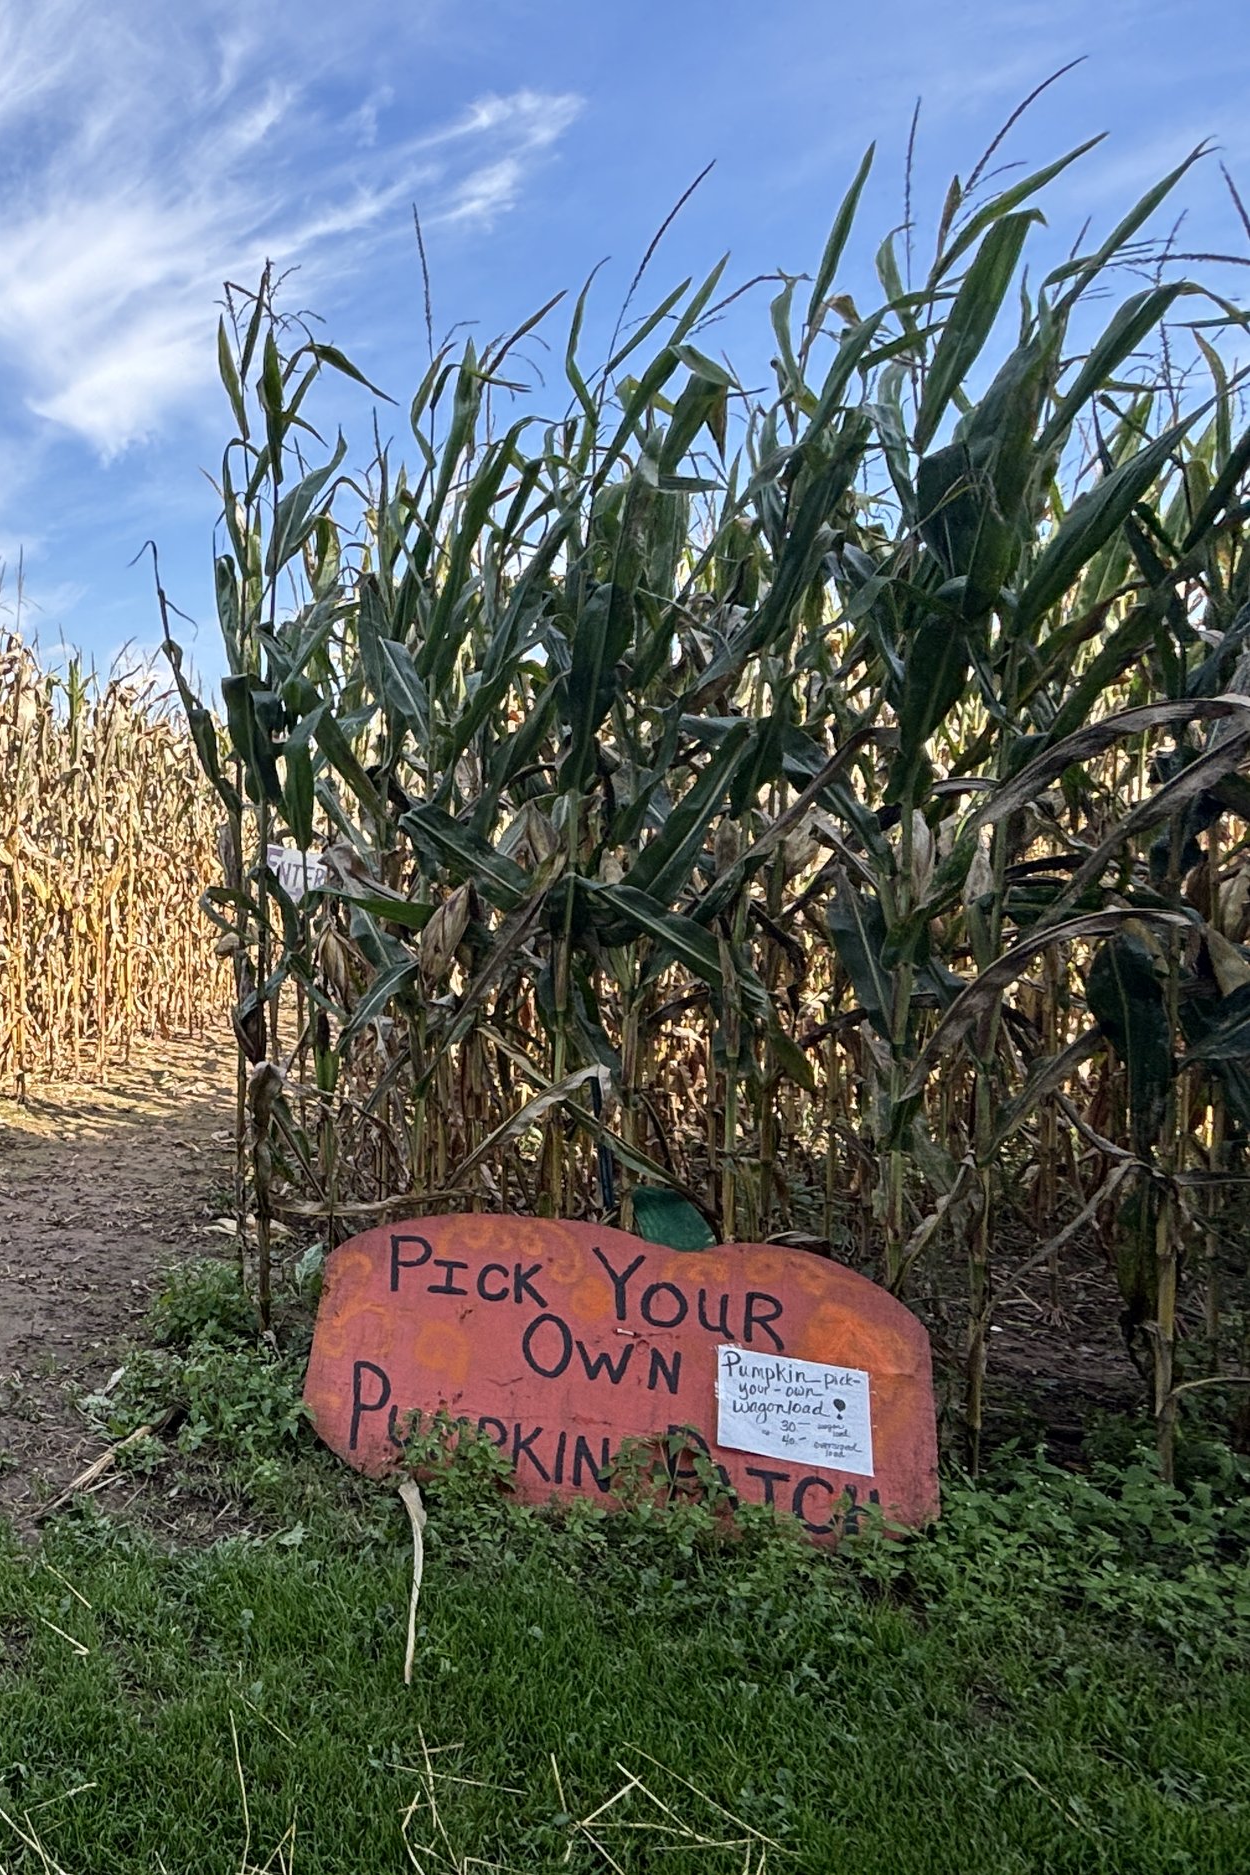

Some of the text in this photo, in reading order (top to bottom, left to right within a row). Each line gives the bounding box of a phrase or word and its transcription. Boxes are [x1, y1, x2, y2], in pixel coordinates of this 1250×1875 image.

[390, 1234, 785, 1352] PICK YOUR
[522, 1313, 682, 1395] OWN
[721, 1350, 821, 1388] Pumpkin
